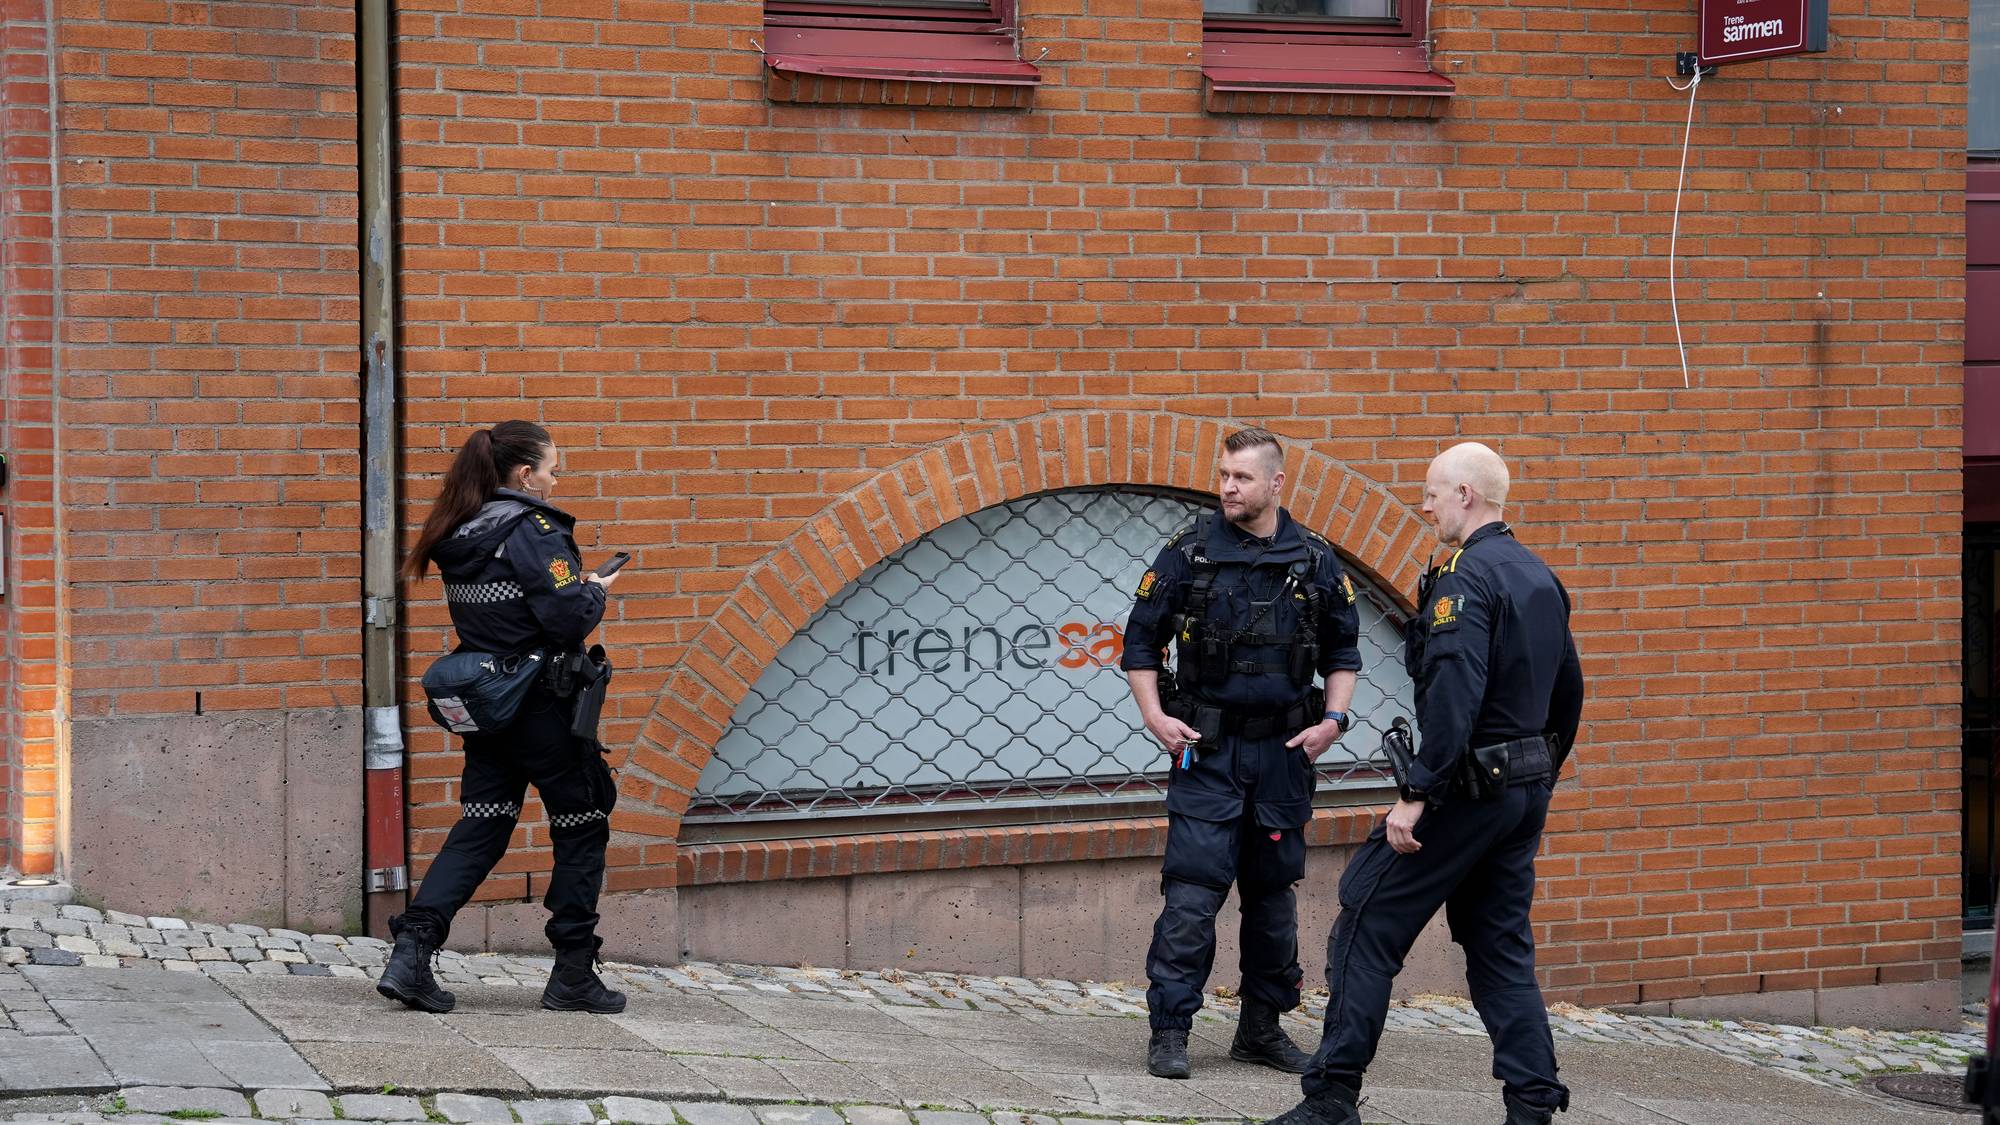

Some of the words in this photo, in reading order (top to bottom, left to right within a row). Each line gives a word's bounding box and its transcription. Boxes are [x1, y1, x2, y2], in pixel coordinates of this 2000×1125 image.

[1724, 16, 1744, 25] Trene
[1723, 18, 1783, 42] sammen
[555, 575, 577, 588] POLITI
[1433, 615, 1456, 627] POLITI
[852, 620, 1125, 676] trenesa
